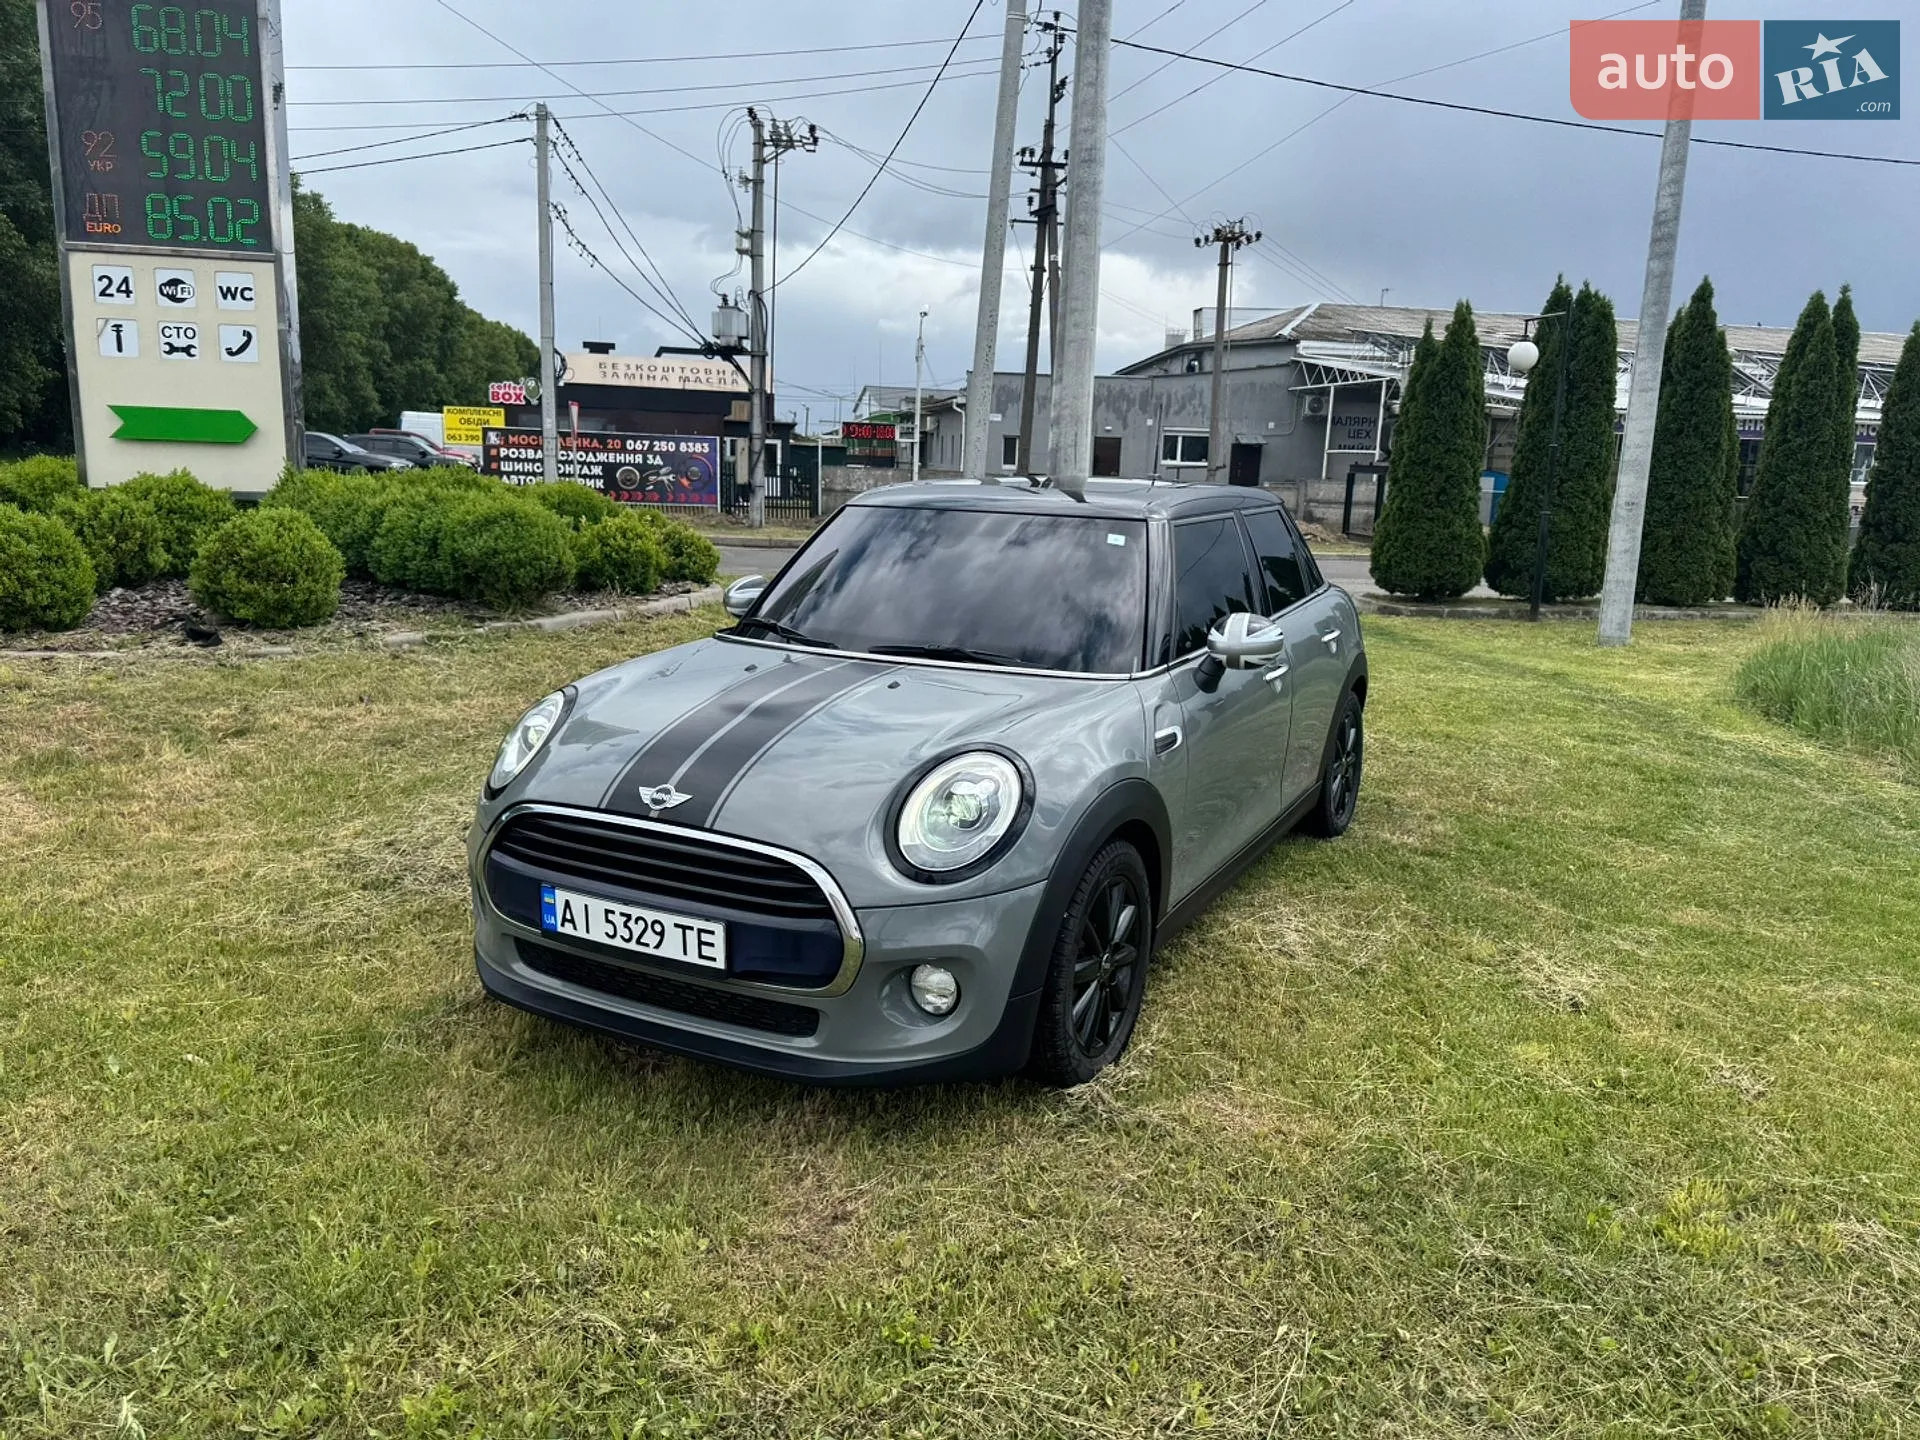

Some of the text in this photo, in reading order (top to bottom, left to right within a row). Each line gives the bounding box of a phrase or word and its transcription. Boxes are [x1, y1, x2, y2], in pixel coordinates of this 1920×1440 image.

[71, 1, 250, 57] 95 68.04
[82, 130, 259, 183] 92 59.04
[145, 193, 260, 247] 85.02
[86, 222, 122, 234] EURO
[97, 274, 134, 299] 24
[218, 285, 255, 302] WC
[161, 325, 197, 340] СТО
[598, 361, 740, 377] БЕЗКОШТОВНА
[600, 371, 670, 382] ЗАМІНА
[491, 391, 524, 403] BOX
[446, 408, 503, 417] КОМПЛЕКСНІ
[458, 417, 490, 427] ОБІДИ
[1347, 428, 1373, 440] ЦЕХ
[606, 439, 622, 450] 20
[626, 439, 650, 451] 067
[653, 440, 676, 452] 250
[679, 441, 710, 454] 8383
[500, 461, 604, 476] ШИНООНТАЖ
[543, 913, 557, 926] UA
[560, 898, 718, 963] AI 5329 TE
